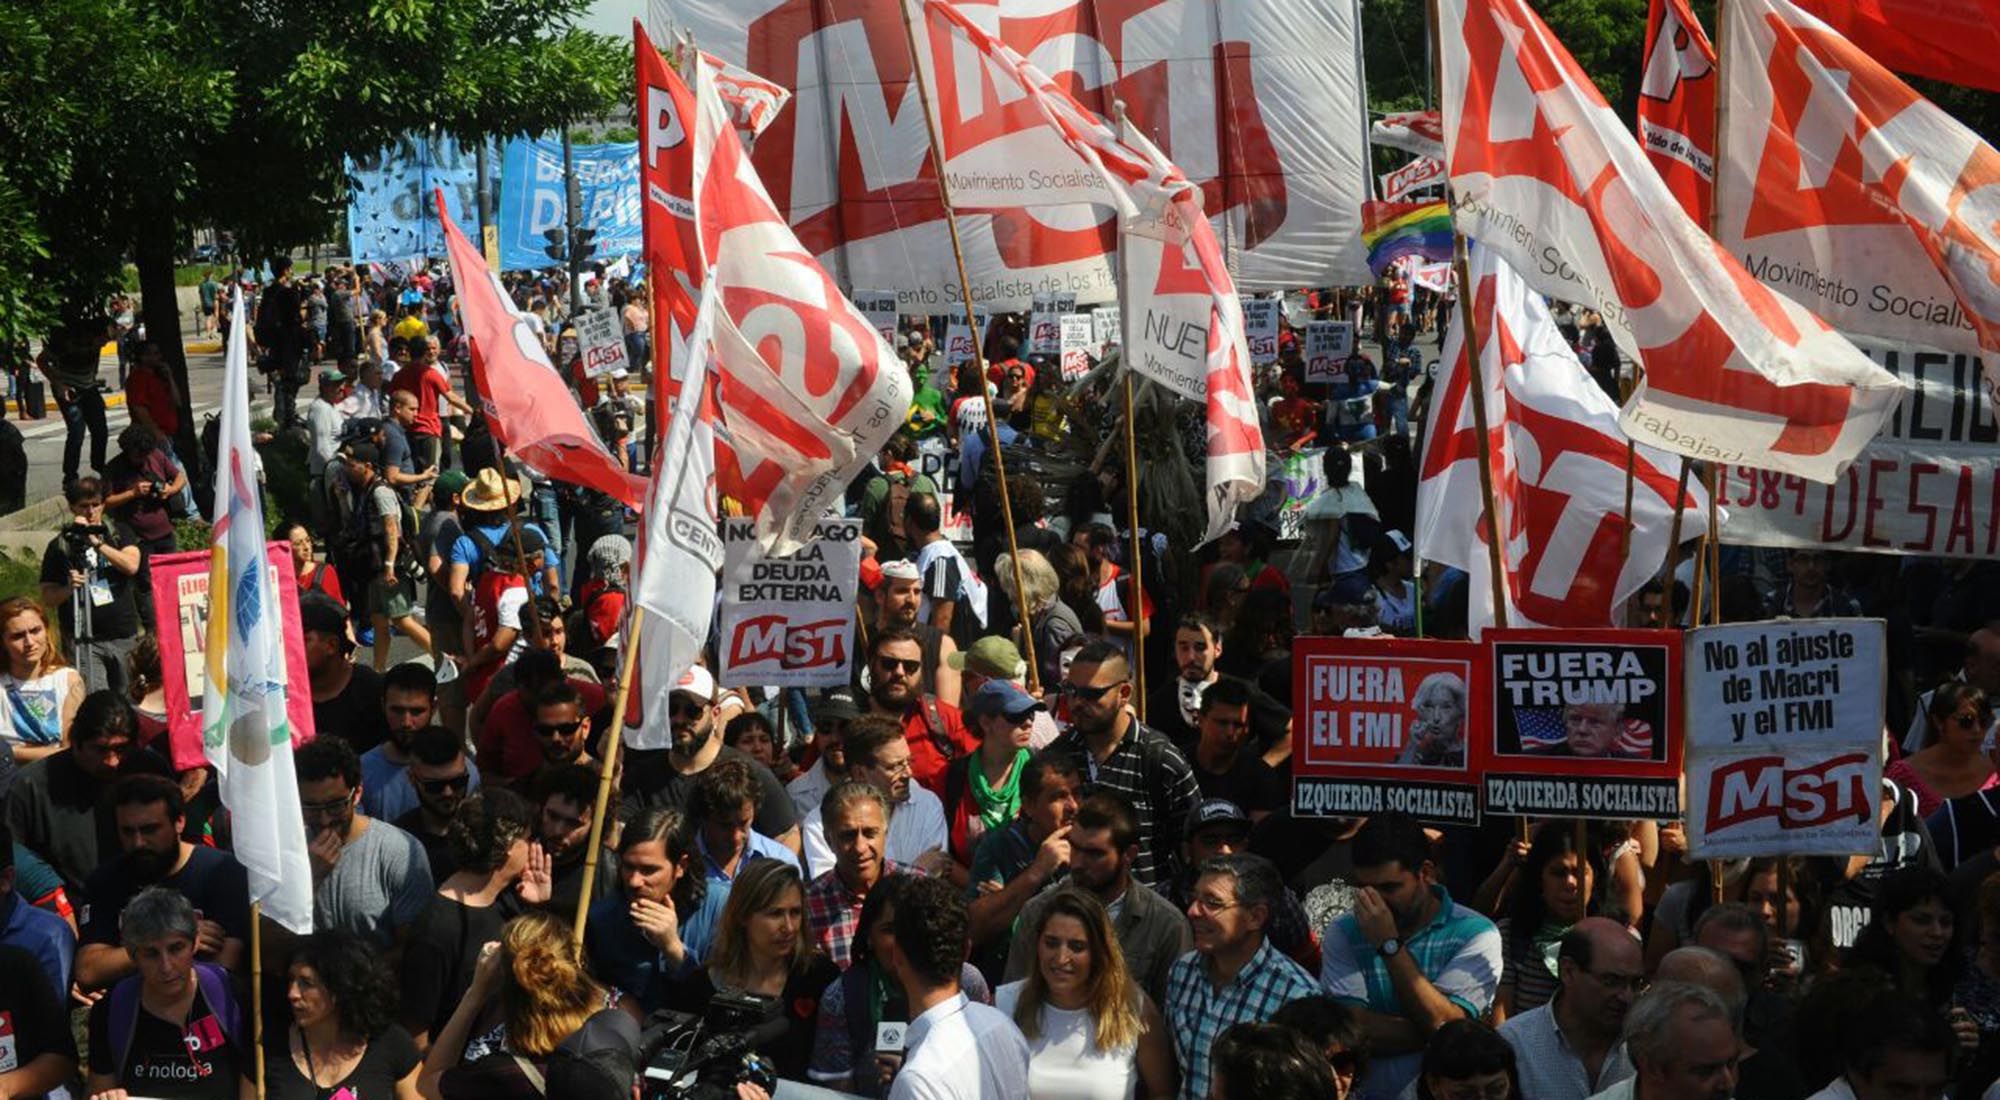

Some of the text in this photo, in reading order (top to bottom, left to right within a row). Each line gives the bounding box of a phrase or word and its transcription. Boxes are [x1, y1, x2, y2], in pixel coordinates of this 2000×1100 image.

[1744, 253, 1977, 331] Movimiento Socialis
[1144, 308, 1210, 364] NUE
[808, 524, 858, 542] AGO
[752, 563, 831, 582] DEUDA
[738, 584, 843, 603] EXTERNA
[733, 618, 847, 668] MST
[1703, 629, 1854, 672] No al ajuste
[1502, 651, 1645, 679] FUERA
[1313, 665, 1405, 704] FUERA
[1504, 678, 1657, 706] TRUMP
[1722, 664, 1840, 705] de Macri
[1313, 711, 1402, 748] EL FMI
[1731, 700, 1834, 743] y el FMI
[1297, 782, 1475, 819] IZQUIERDA SOCIALISTA
[1487, 779, 1677, 814] IZQUIERDA SOCIALISTA
[1710, 756, 1868, 830] MST
